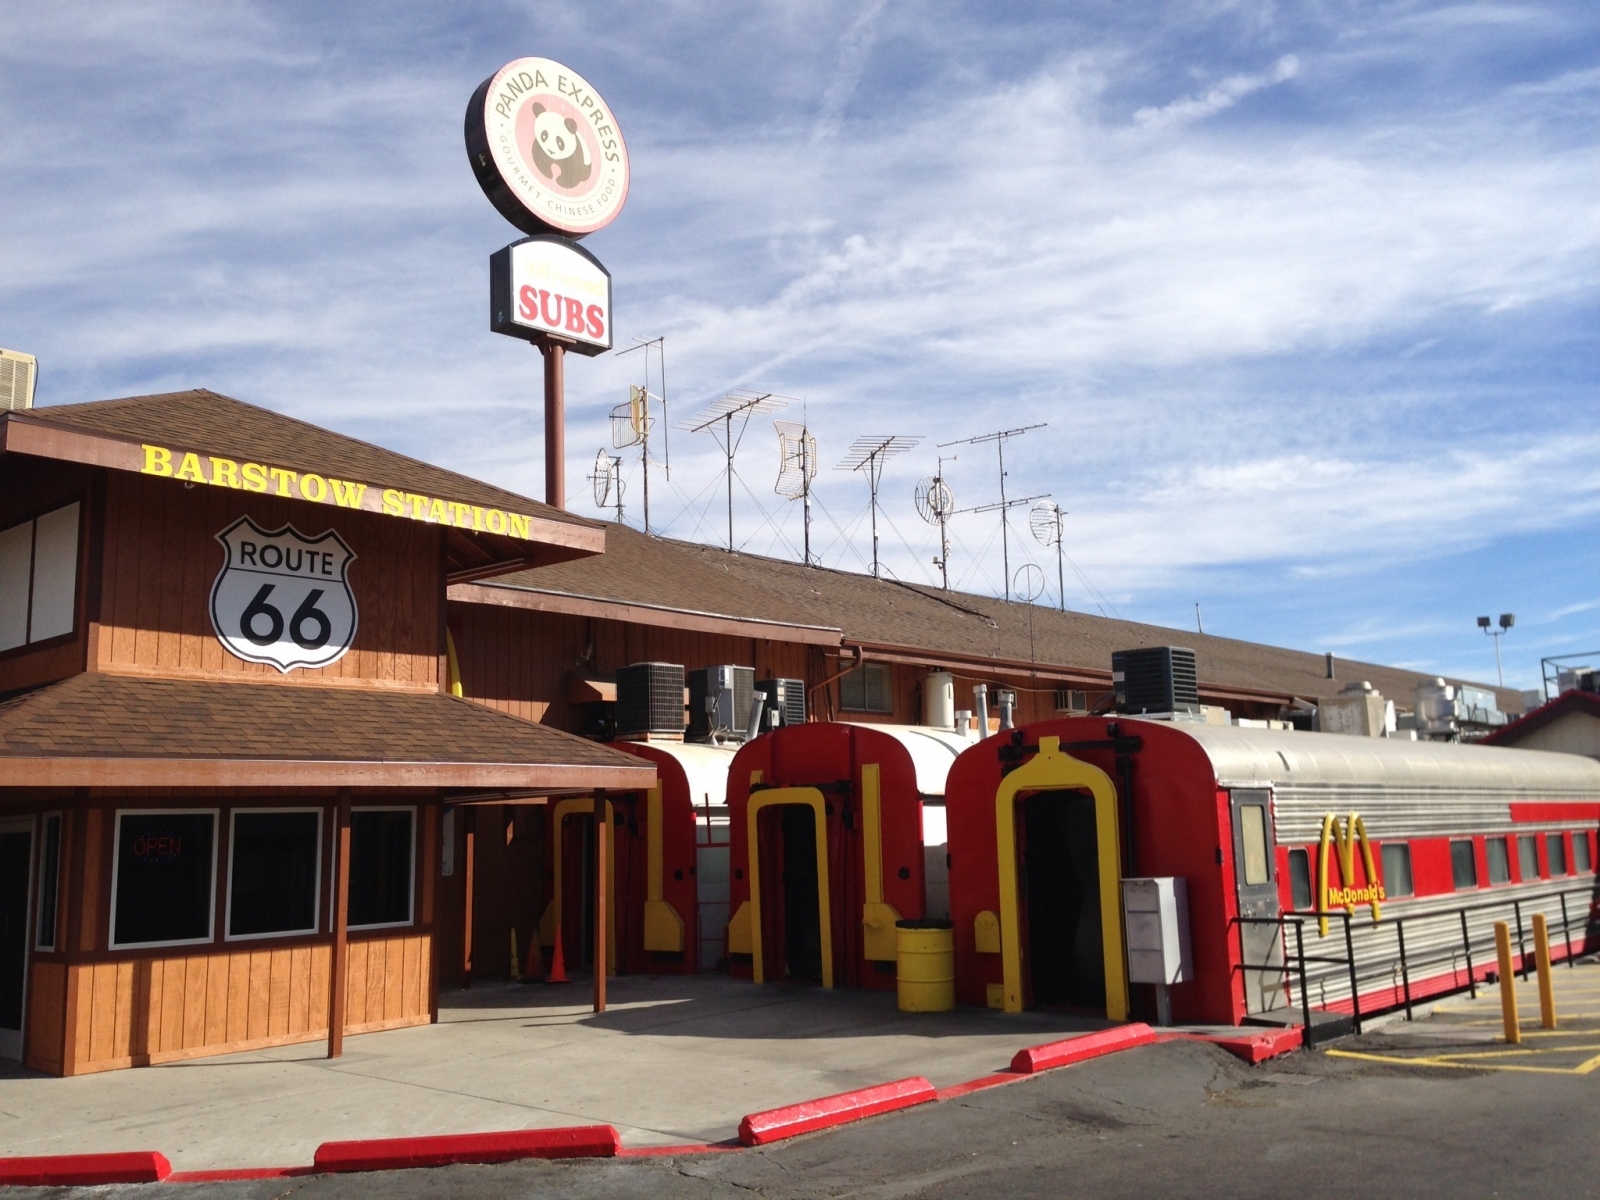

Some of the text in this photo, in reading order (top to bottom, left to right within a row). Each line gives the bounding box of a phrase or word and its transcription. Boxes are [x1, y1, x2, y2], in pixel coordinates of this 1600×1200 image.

[496, 69, 620, 163] PANDA EXPRESS
[499, 136, 616, 216] GOURMET CHINESE FOOD
[519, 284, 605, 339] SUBS
[140, 443, 532, 541] BARSTOW STATION
[239, 540, 335, 576] ROUTE
[239, 583, 332, 650] 66
[133, 837, 182, 855] OPEN
[1329, 882, 1385, 905] McDonald's
